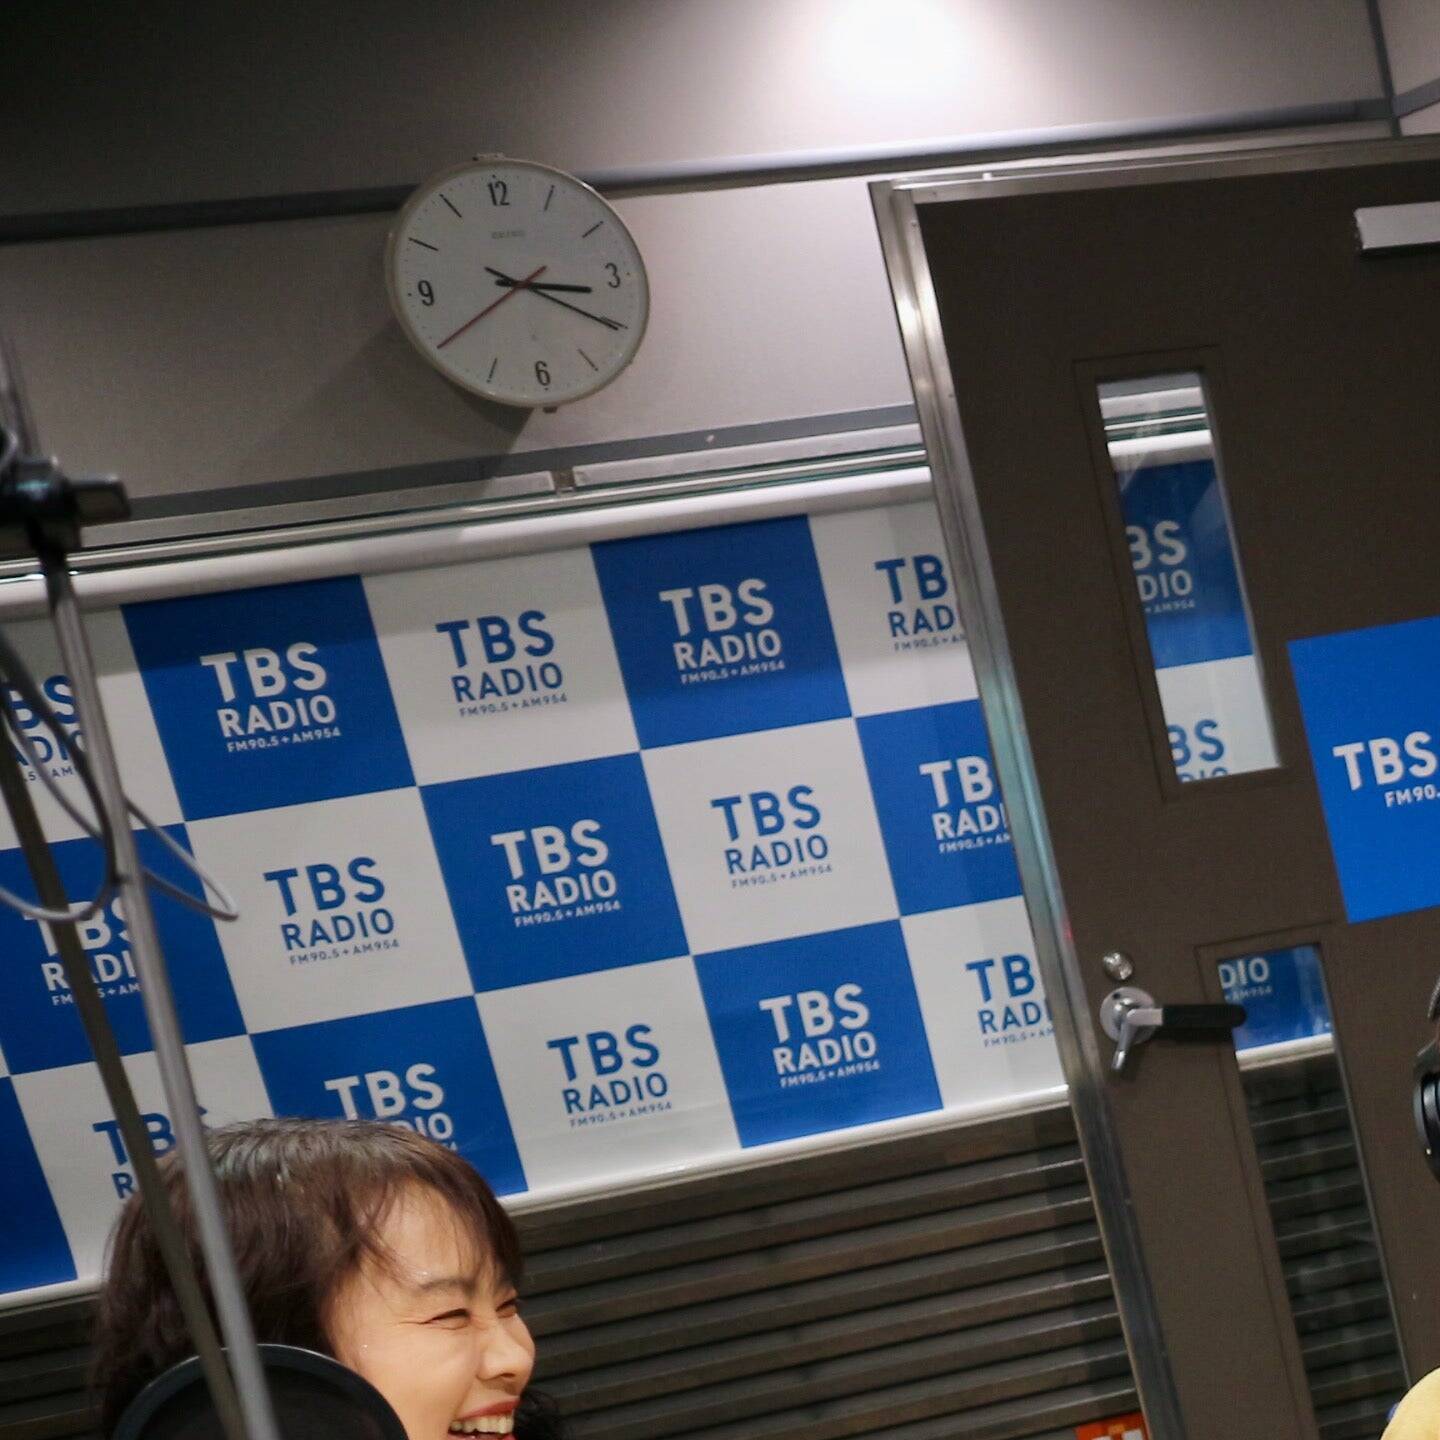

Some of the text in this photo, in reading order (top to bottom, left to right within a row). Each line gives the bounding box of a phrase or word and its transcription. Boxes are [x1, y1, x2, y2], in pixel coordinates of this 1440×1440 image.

[487, 180, 510, 206] 12
[418, 279, 434, 306] 9
[604, 263, 620, 288] 3
[535, 360, 550, 386] 6
[1125, 521, 1187, 570] BS
[875, 554, 948, 603] TB
[1137, 570, 1192, 602] DIO
[658, 578, 774, 637] TBS
[887, 608, 955, 638] RAD
[435, 610, 554, 668] TBS
[672, 629, 783, 670] RADIO
[201, 641, 327, 703] TBS
[451, 661, 563, 703] RADIO
[8, 675, 80, 729] BS
[216, 694, 337, 739] RADIO
[1167, 718, 1226, 766] BS
[919, 755, 993, 808] TB
[711, 784, 822, 841] TBS
[931, 802, 1007, 841] RADI
[490, 818, 609, 880] TBS
[724, 835, 829, 875] RADIO
[263, 856, 386, 916] TBS
[505, 869, 618, 915] RADIO
[279, 907, 395, 950] RADIO
[966, 955, 1034, 1002] TB
[1218, 956, 1269, 988] DIO
[759, 983, 869, 1043] TBS
[978, 1000, 1051, 1035] RADI
[546, 1024, 660, 1083] TBS
[772, 1032, 877, 1077] RADIO
[324, 1063, 445, 1122] TBS
[561, 1073, 668, 1115] RADIO
